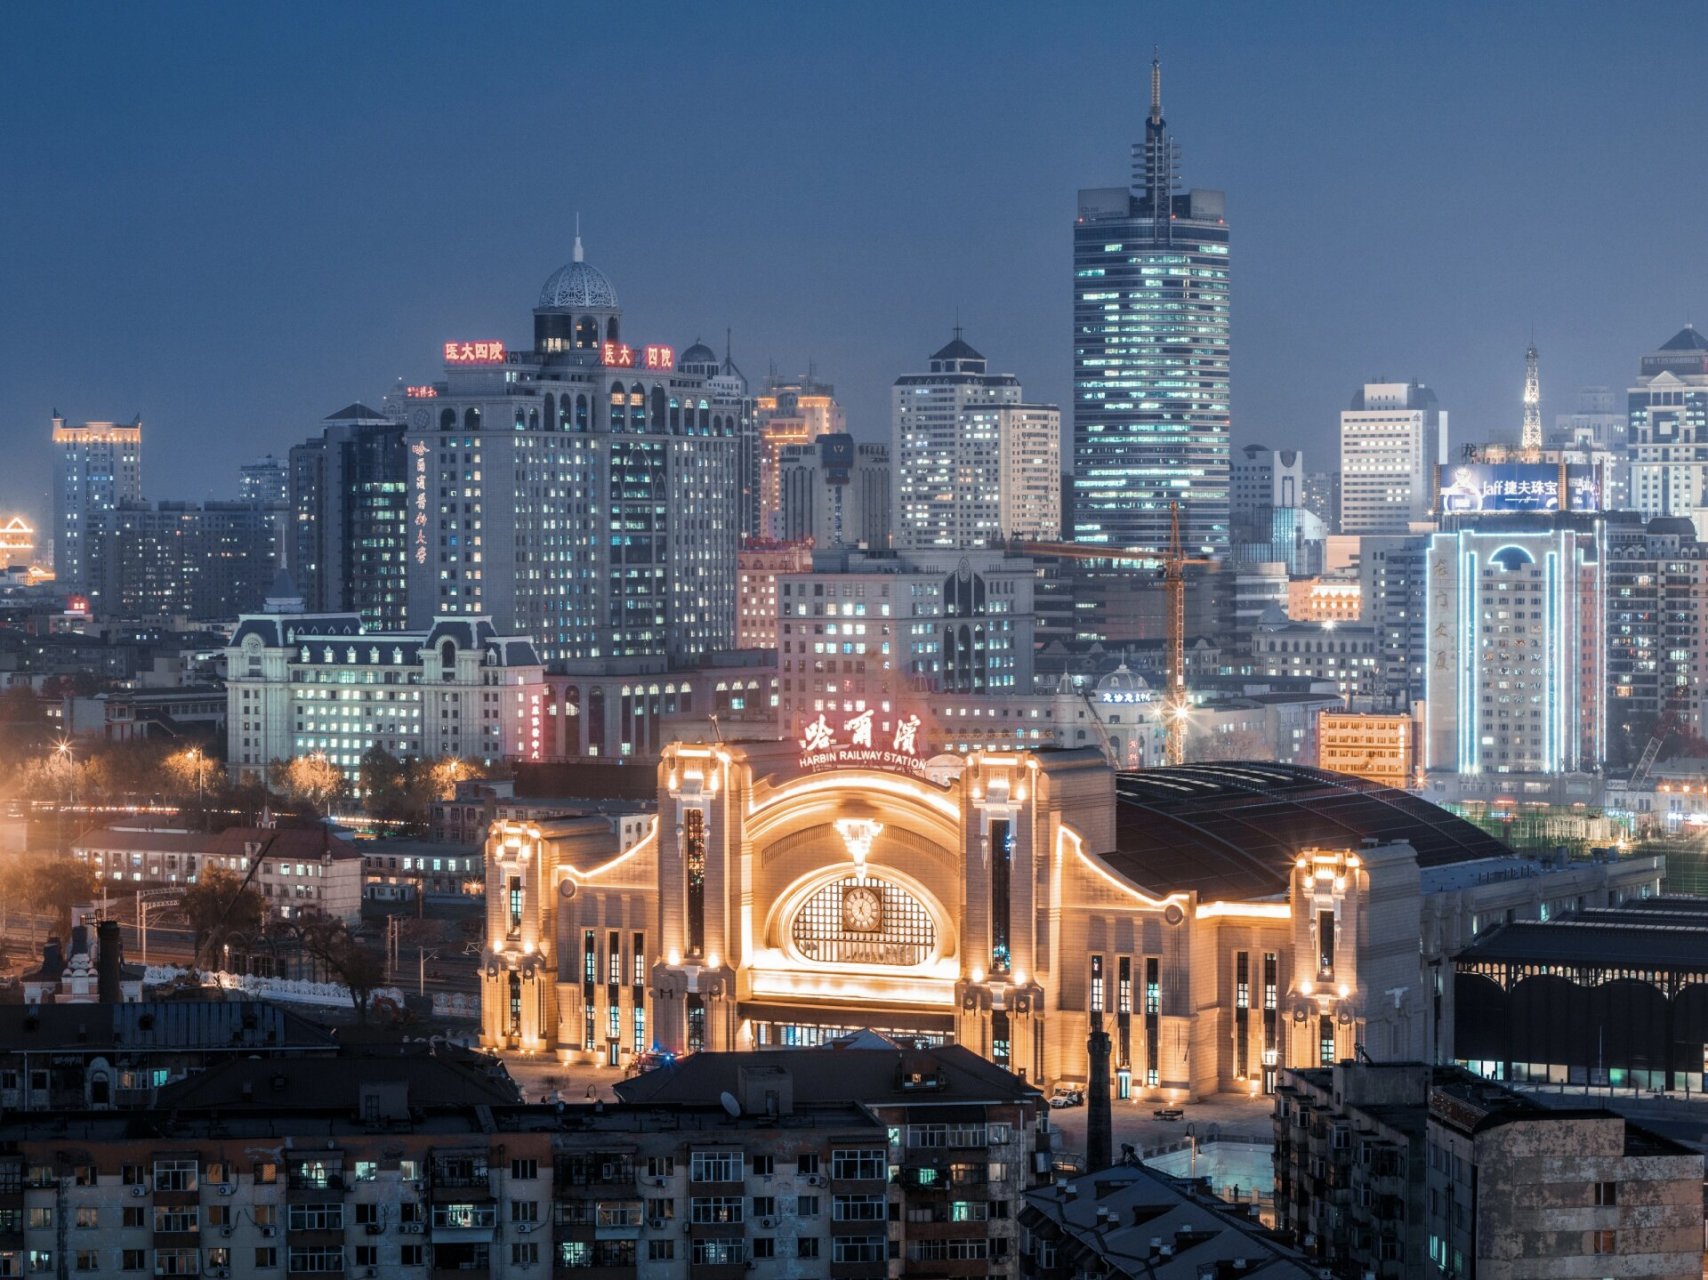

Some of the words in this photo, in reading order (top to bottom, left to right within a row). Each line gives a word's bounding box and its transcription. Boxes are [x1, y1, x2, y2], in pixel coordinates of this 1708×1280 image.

[445, 342, 503, 361] 医大四院
[1482, 480, 1503, 498] Jaff
[1504, 480, 1558, 495] 捷夫珠宝
[799, 752, 837, 768] HARBIN
[839, 750, 883, 761] RAILWAY
[883, 752, 927, 769] STATION
